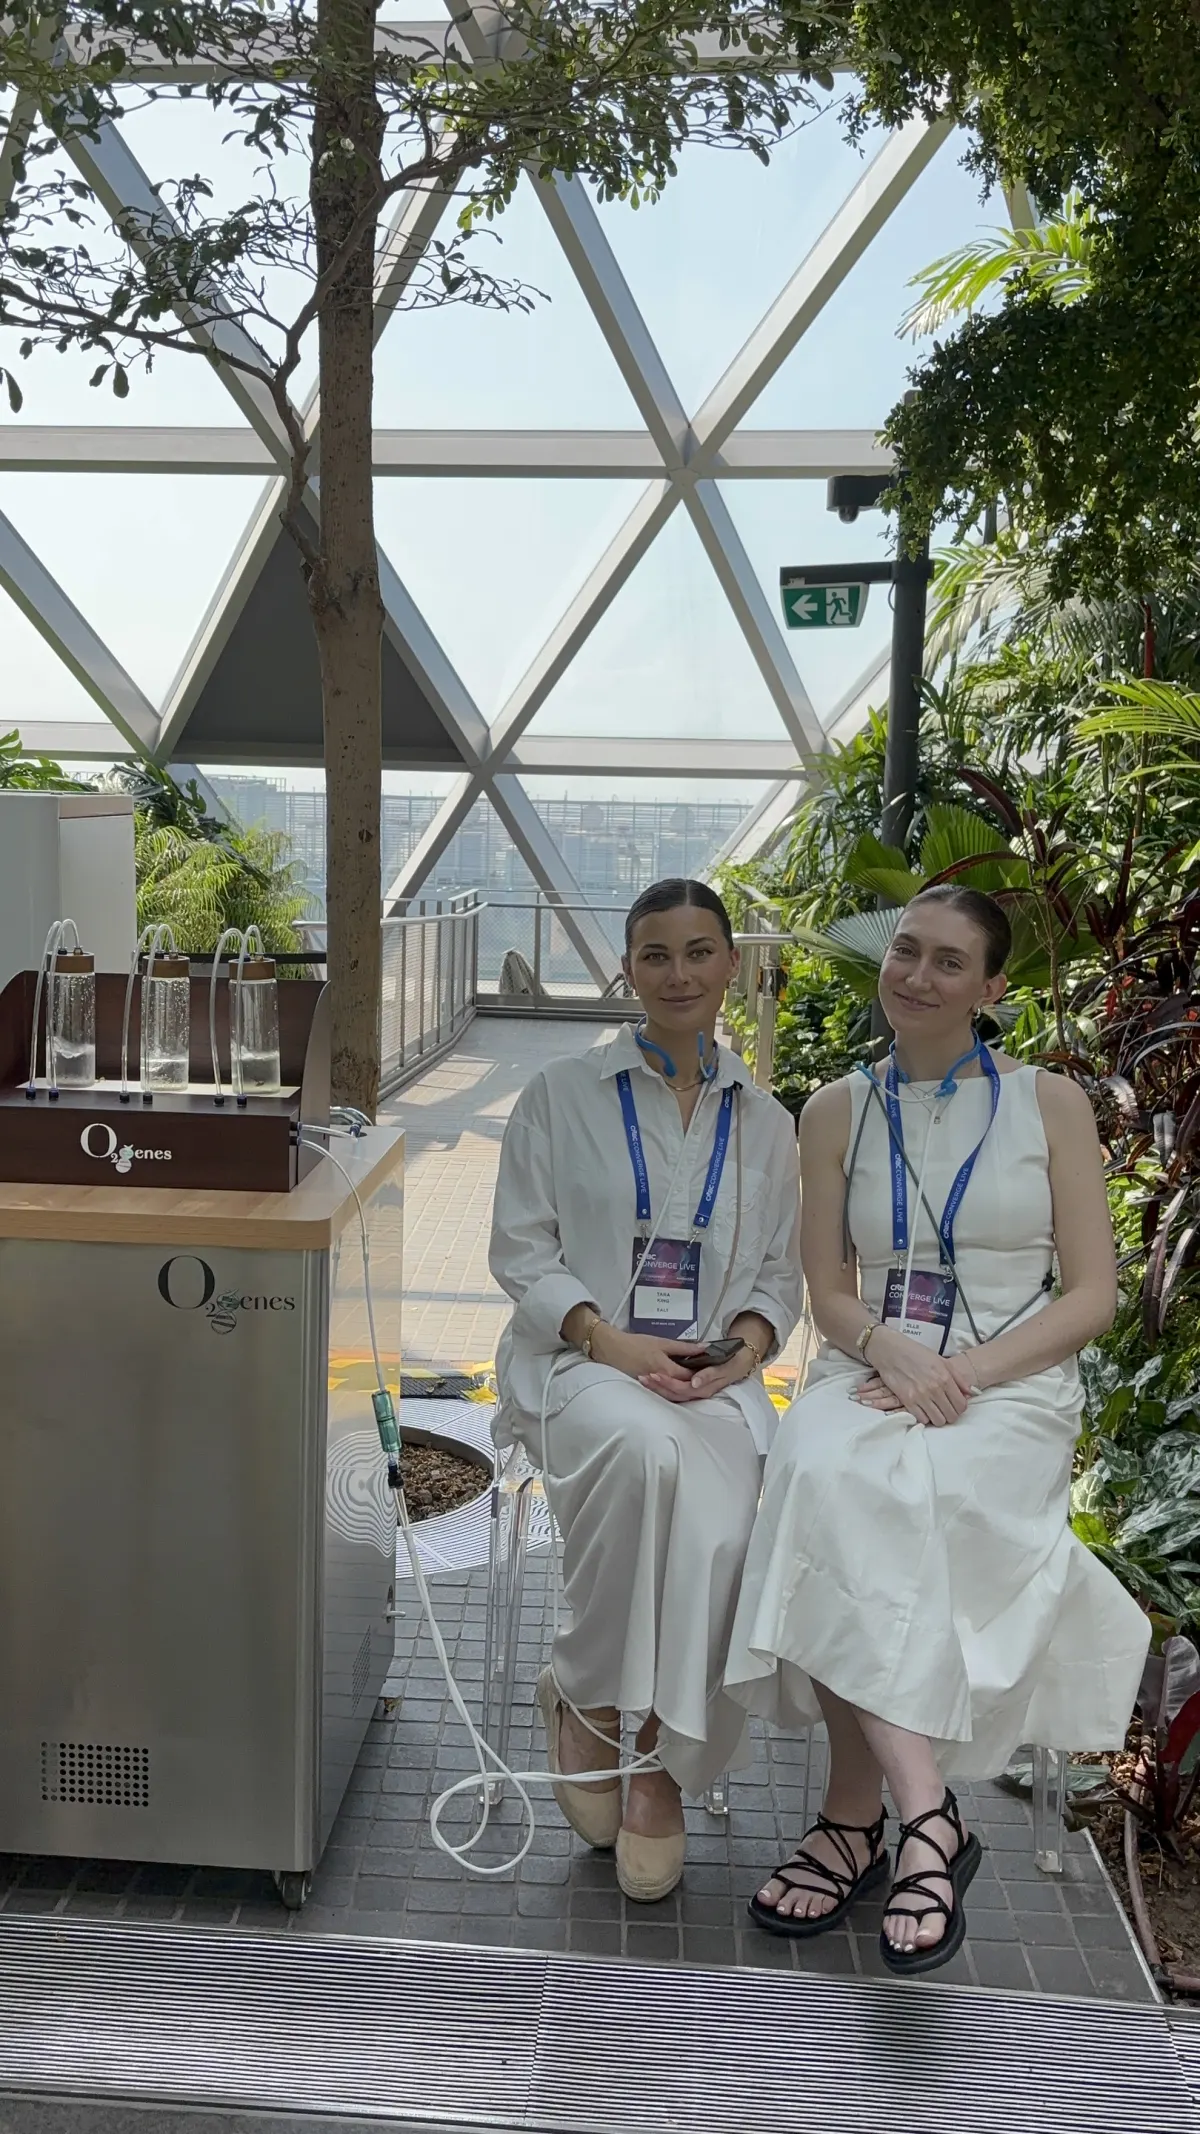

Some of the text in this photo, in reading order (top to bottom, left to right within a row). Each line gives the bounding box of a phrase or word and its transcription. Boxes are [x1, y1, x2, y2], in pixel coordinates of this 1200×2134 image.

[633, 1141, 645, 1178] CONVERGE
[639, 1178, 647, 1193] LIVE
[709, 1151, 723, 1184] CONVERGE
[895, 1169, 904, 1206] CONVERGE
[945, 1183, 964, 1220] CONVERGE
[959, 1167, 970, 1182] LIVE
[896, 1206, 904, 1223] LIVE
[679, 1263, 696, 1271] LIVE
[932, 1297, 951, 1307] LIVE
